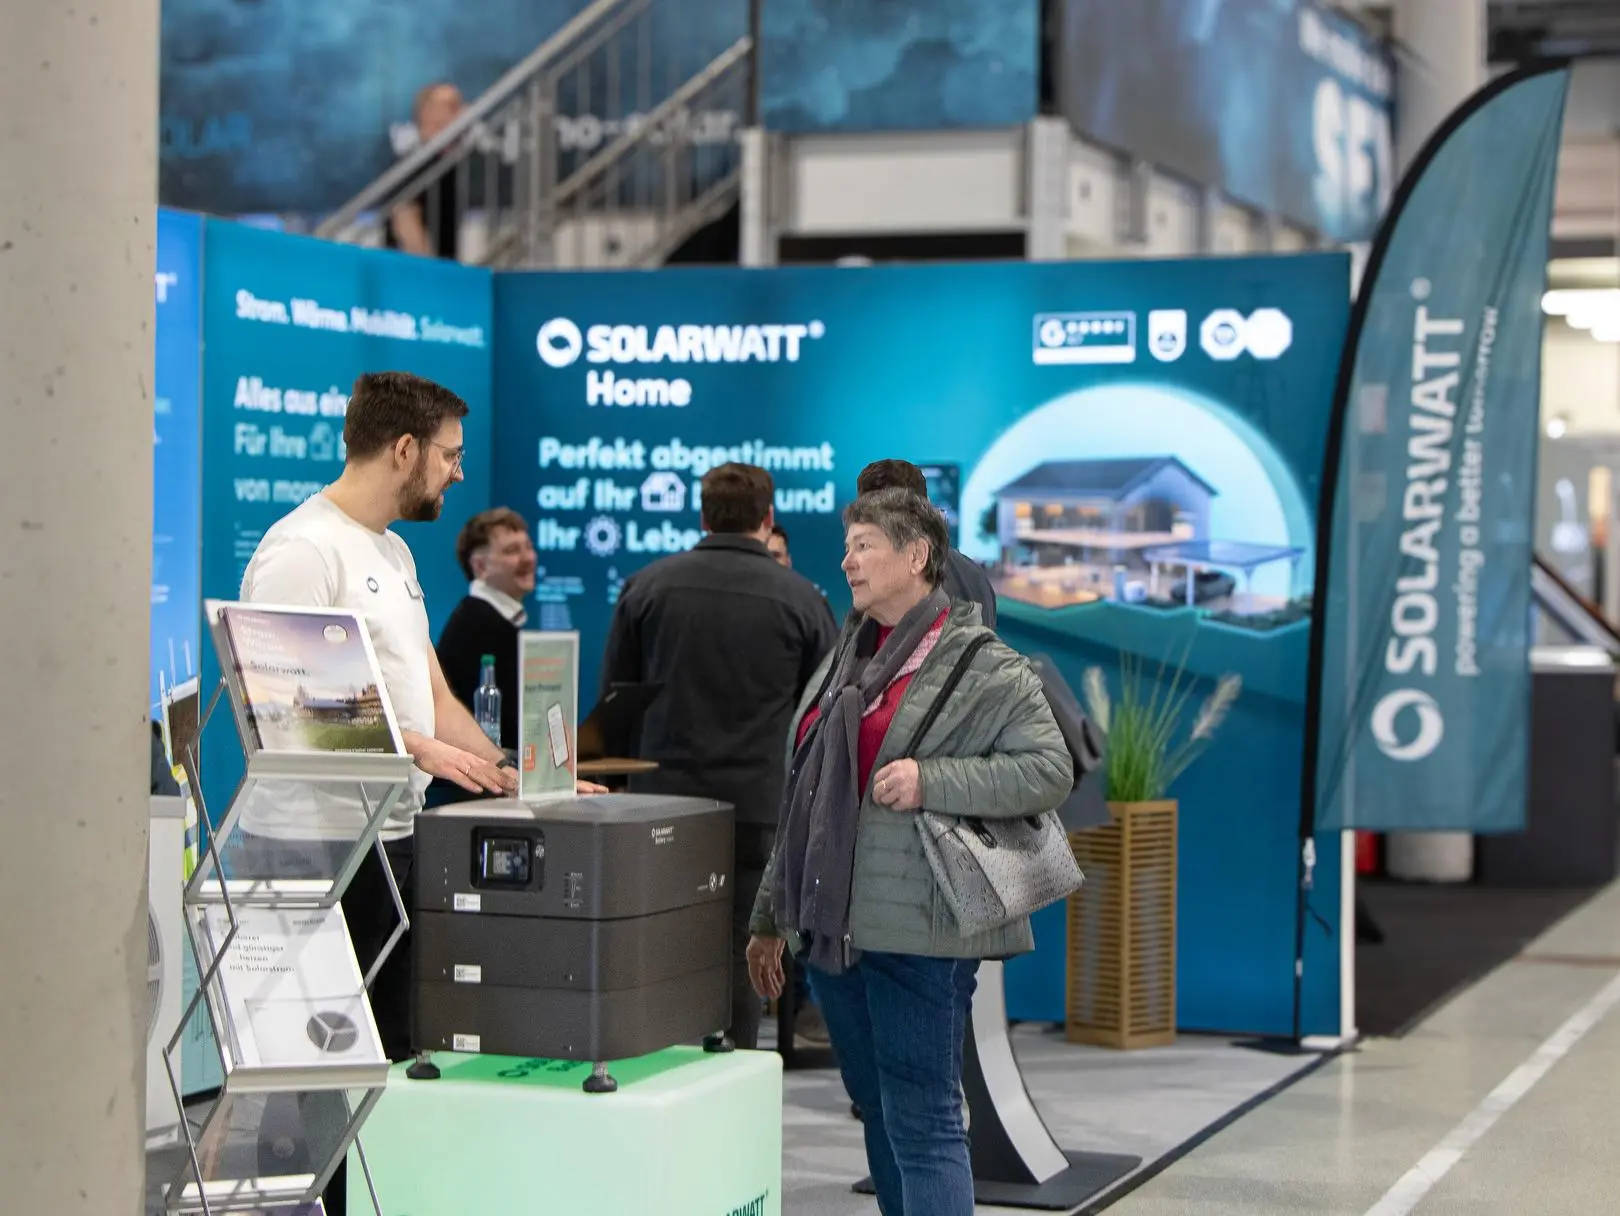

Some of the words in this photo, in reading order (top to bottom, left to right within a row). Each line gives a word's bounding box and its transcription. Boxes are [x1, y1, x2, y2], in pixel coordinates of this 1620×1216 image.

[234, 376, 282, 413] Alles
[284, 388, 318, 416] aus
[586, 369, 692, 406] Home
[234, 422, 267, 457] Für
[269, 425, 307, 460] Ihre
[538, 437, 646, 470] Perfekt
[651, 437, 835, 477] abgestimmt
[234, 478, 270, 503] von
[537, 477, 590, 511] auf
[593, 478, 637, 511] Ihr
[774, 481, 836, 513] und
[1454, 438, 1482, 521] better
[537, 519, 580, 551] Ihr
[625, 519, 709, 552] Lebe
[1459, 524, 1480, 546] a
[1453, 549, 1485, 676] powering
